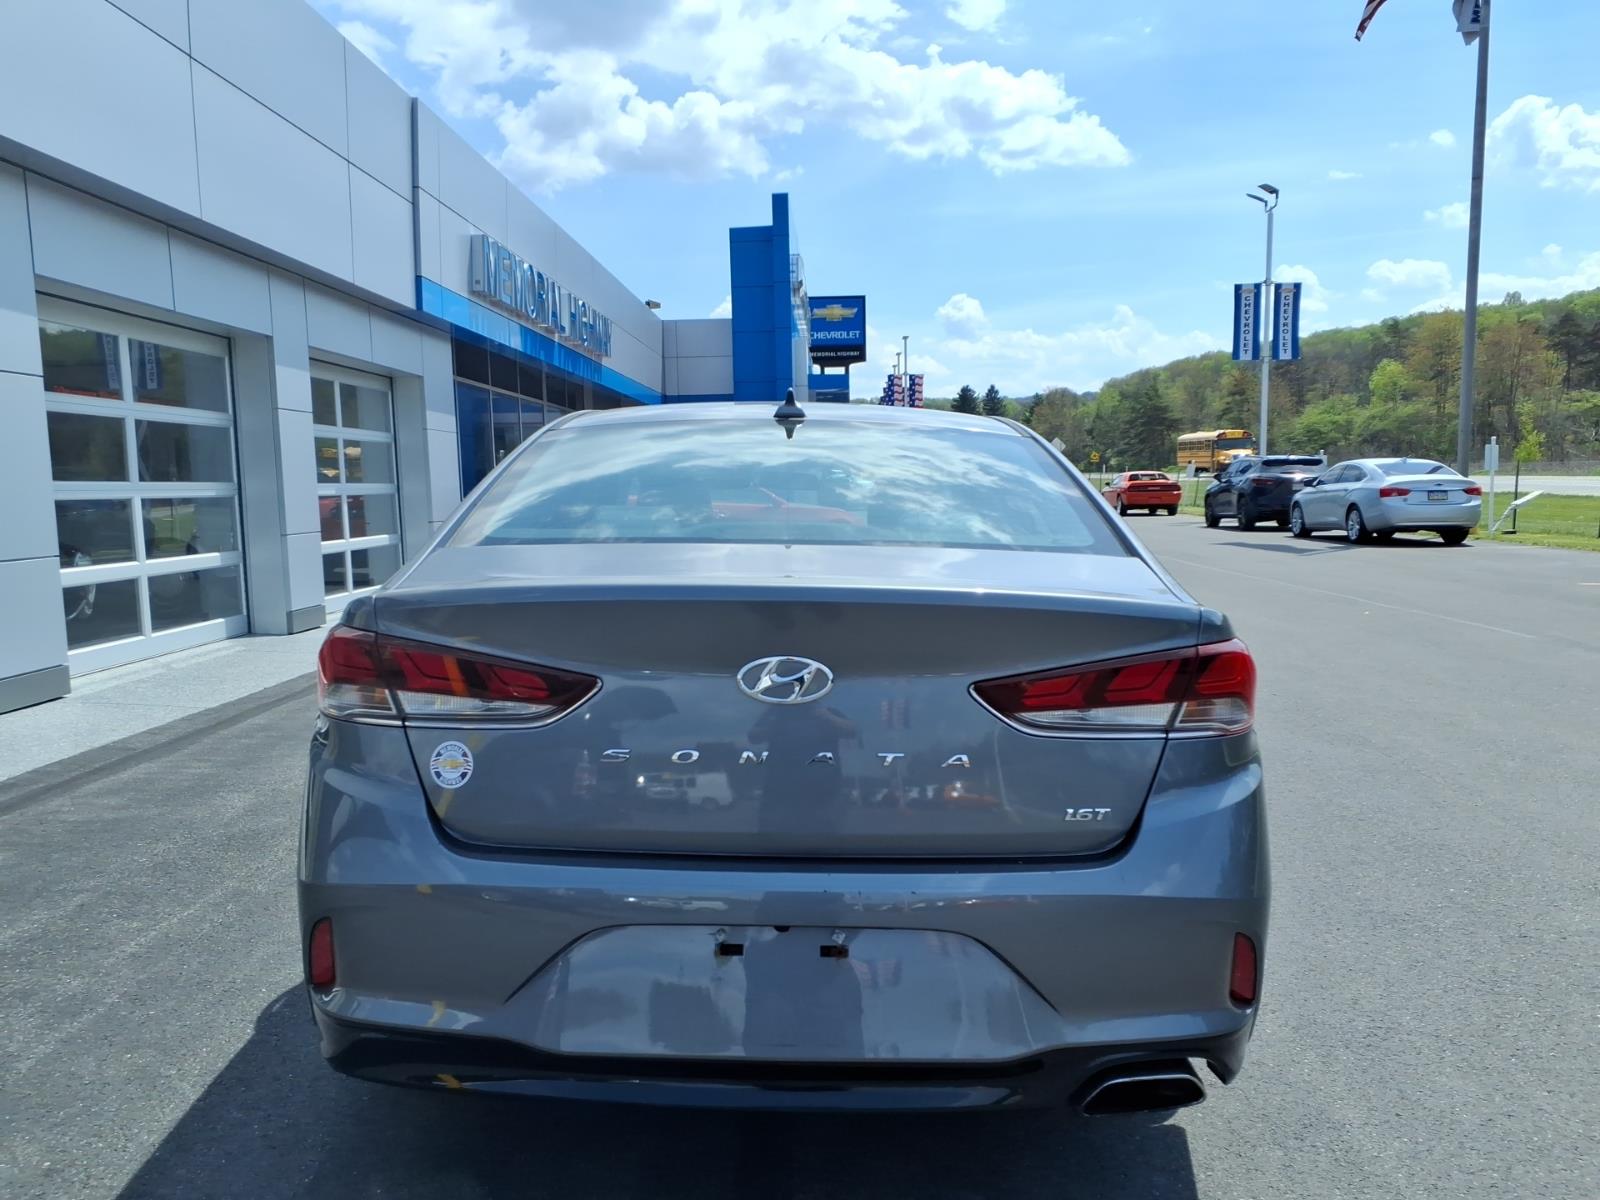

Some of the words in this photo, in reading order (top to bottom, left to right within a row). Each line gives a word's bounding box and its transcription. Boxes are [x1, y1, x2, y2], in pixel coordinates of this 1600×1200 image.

[1243, 295, 1252, 355] CHEVROLET
[1282, 294, 1290, 354] CHEVROLET
[600, 749, 970, 768] SONATA
